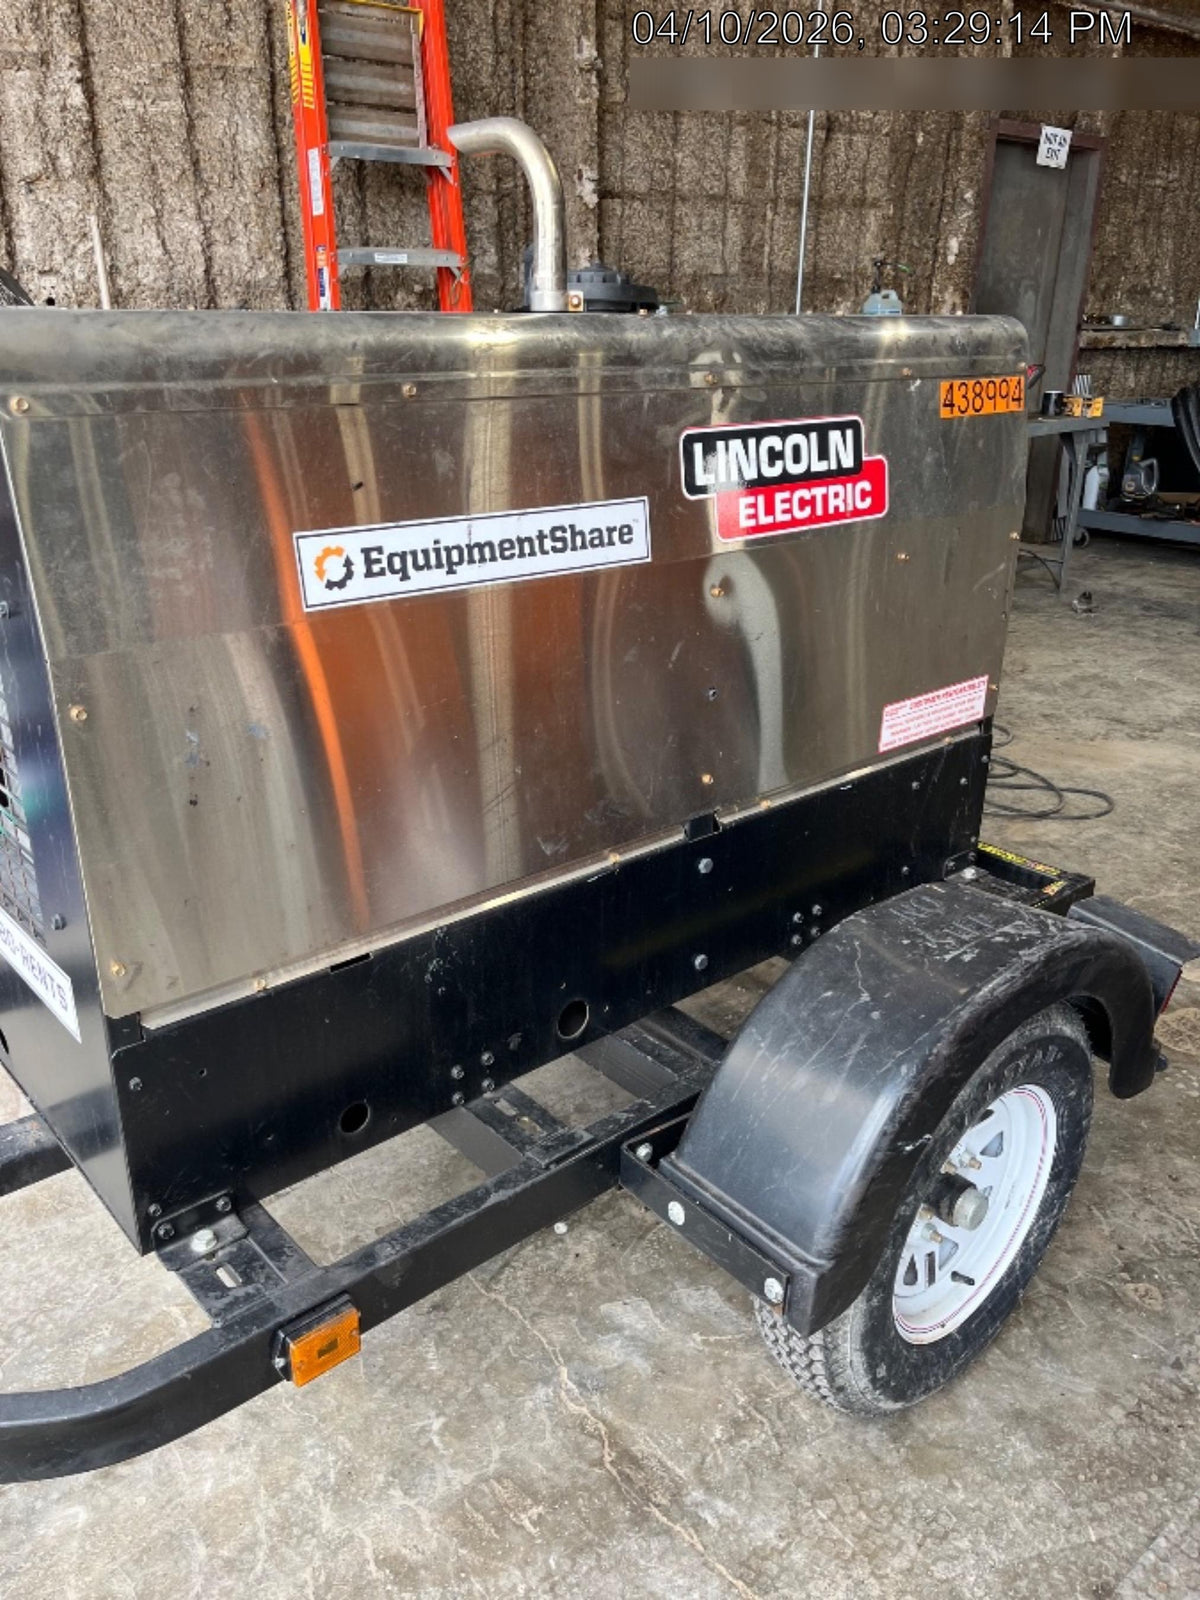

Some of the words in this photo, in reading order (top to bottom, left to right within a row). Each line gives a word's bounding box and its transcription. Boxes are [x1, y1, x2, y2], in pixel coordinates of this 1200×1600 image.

[943, 378, 1022, 415] 438994
[693, 428, 854, 486] LINCOLN
[738, 480, 872, 529] ELECTRIC
[360, 522, 634, 582] EquipmentShare
